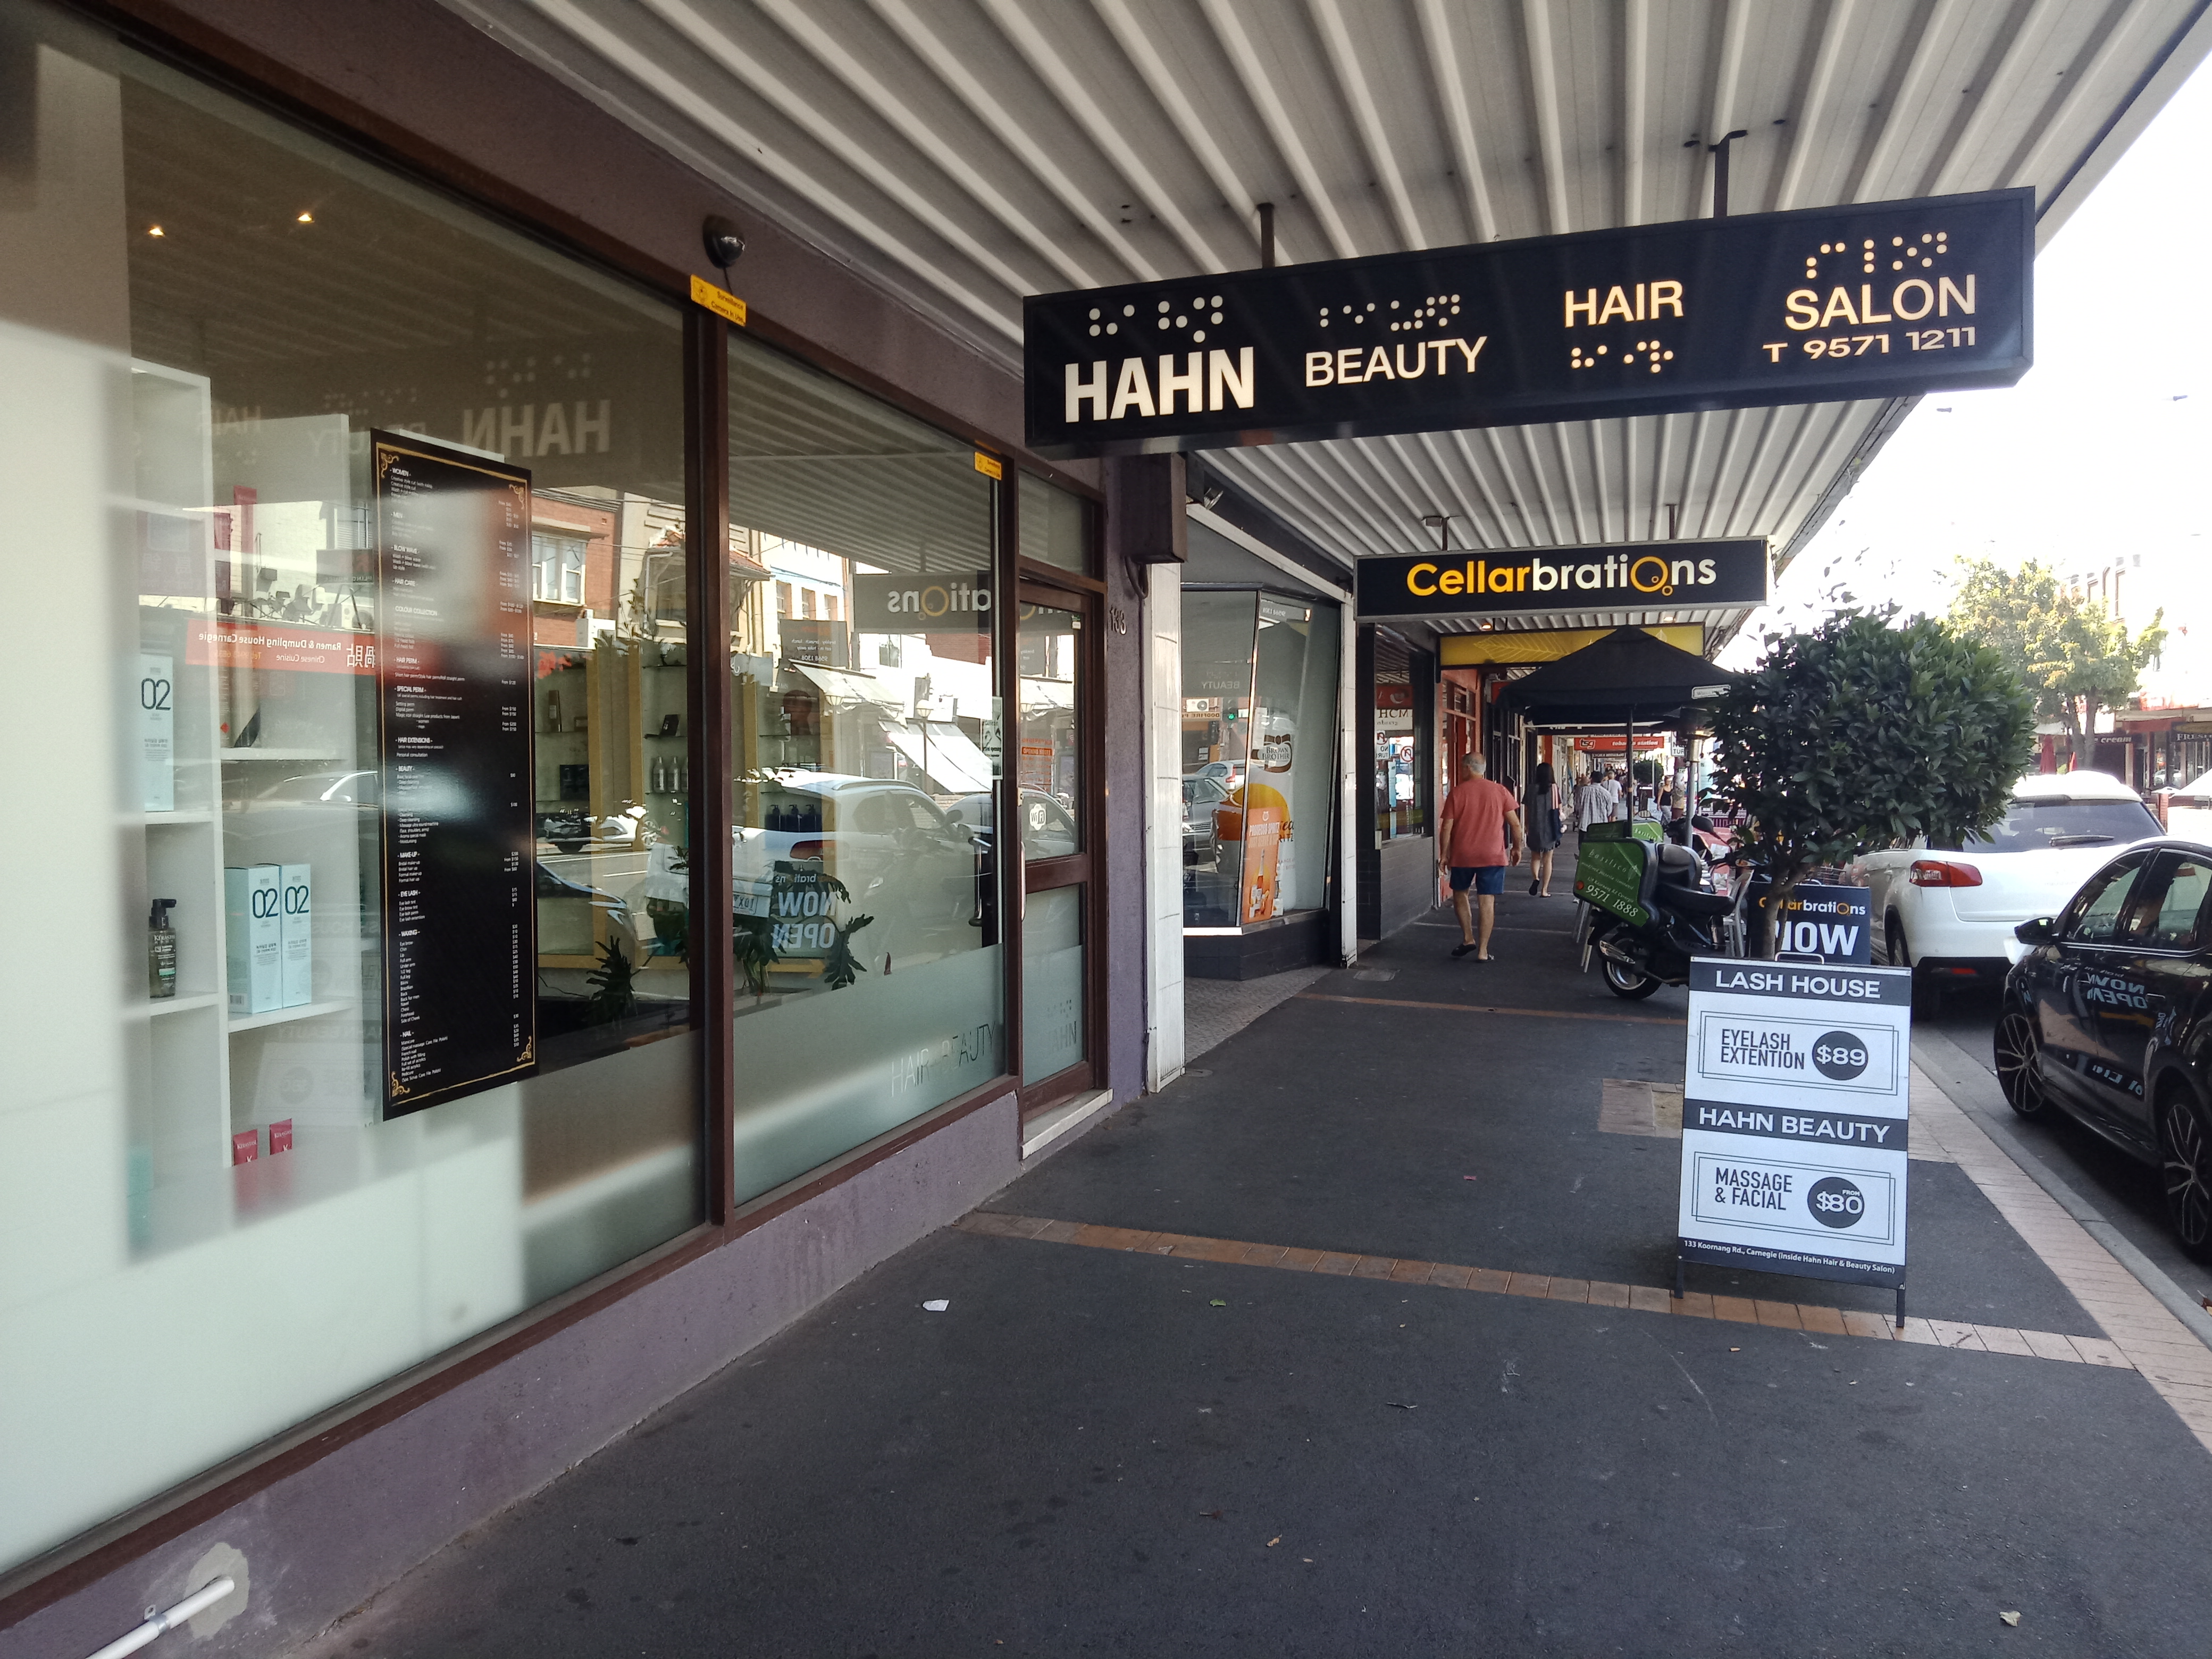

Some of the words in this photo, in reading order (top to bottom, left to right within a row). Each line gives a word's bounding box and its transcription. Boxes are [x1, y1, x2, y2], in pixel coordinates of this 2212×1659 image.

[1065, 346, 1254, 423] HAHN
[1305, 336, 1487, 388] BEAUTY
[1564, 280, 1683, 328] HAIR
[1785, 274, 1976, 331] SALON
[1763, 342, 1788, 364] T
[1804, 334, 1890, 361] 9571
[1906, 326, 1976, 351] 1211
[1109, 605, 1126, 635] 133
[141, 678, 171, 710] 02
[1588, 849, 1627, 873] basilico
[253, 889, 279, 918] 02
[285, 885, 309, 915] 02
[1586, 885, 1610, 902] 9571
[1612, 899, 1638, 917] 1888
[1716, 970, 1783, 992] LASH
[1791, 975, 1881, 999] HOUSE
[1722, 1028, 1790, 1051] EYELASH
[892, 1048, 929, 1097] HAIR
[942, 1021, 995, 1067] BEAUTY
[1721, 1046, 1805, 1070] EXTENTION
[1816, 1044, 1866, 1067] $89
[1699, 1107, 1773, 1132] HAHN
[1782, 1116, 1890, 1143] BEAUTY
[1715, 1167, 1792, 1193] MASSAGE
[1715, 1187, 1726, 1203] &
[1732, 1187, 1787, 1211] FACIAL
[1816, 1191, 1863, 1214] $80
[1698, 1242, 1731, 1254] Koornang
[1747, 1248, 1777, 1260] Carnegie
[1803, 1255, 1822, 1264] Hahn
[1823, 1258, 1838, 1267] Hair
[1846, 1261, 1871, 1271] Beauty
[1872, 1264, 1896, 1274] Salon)
